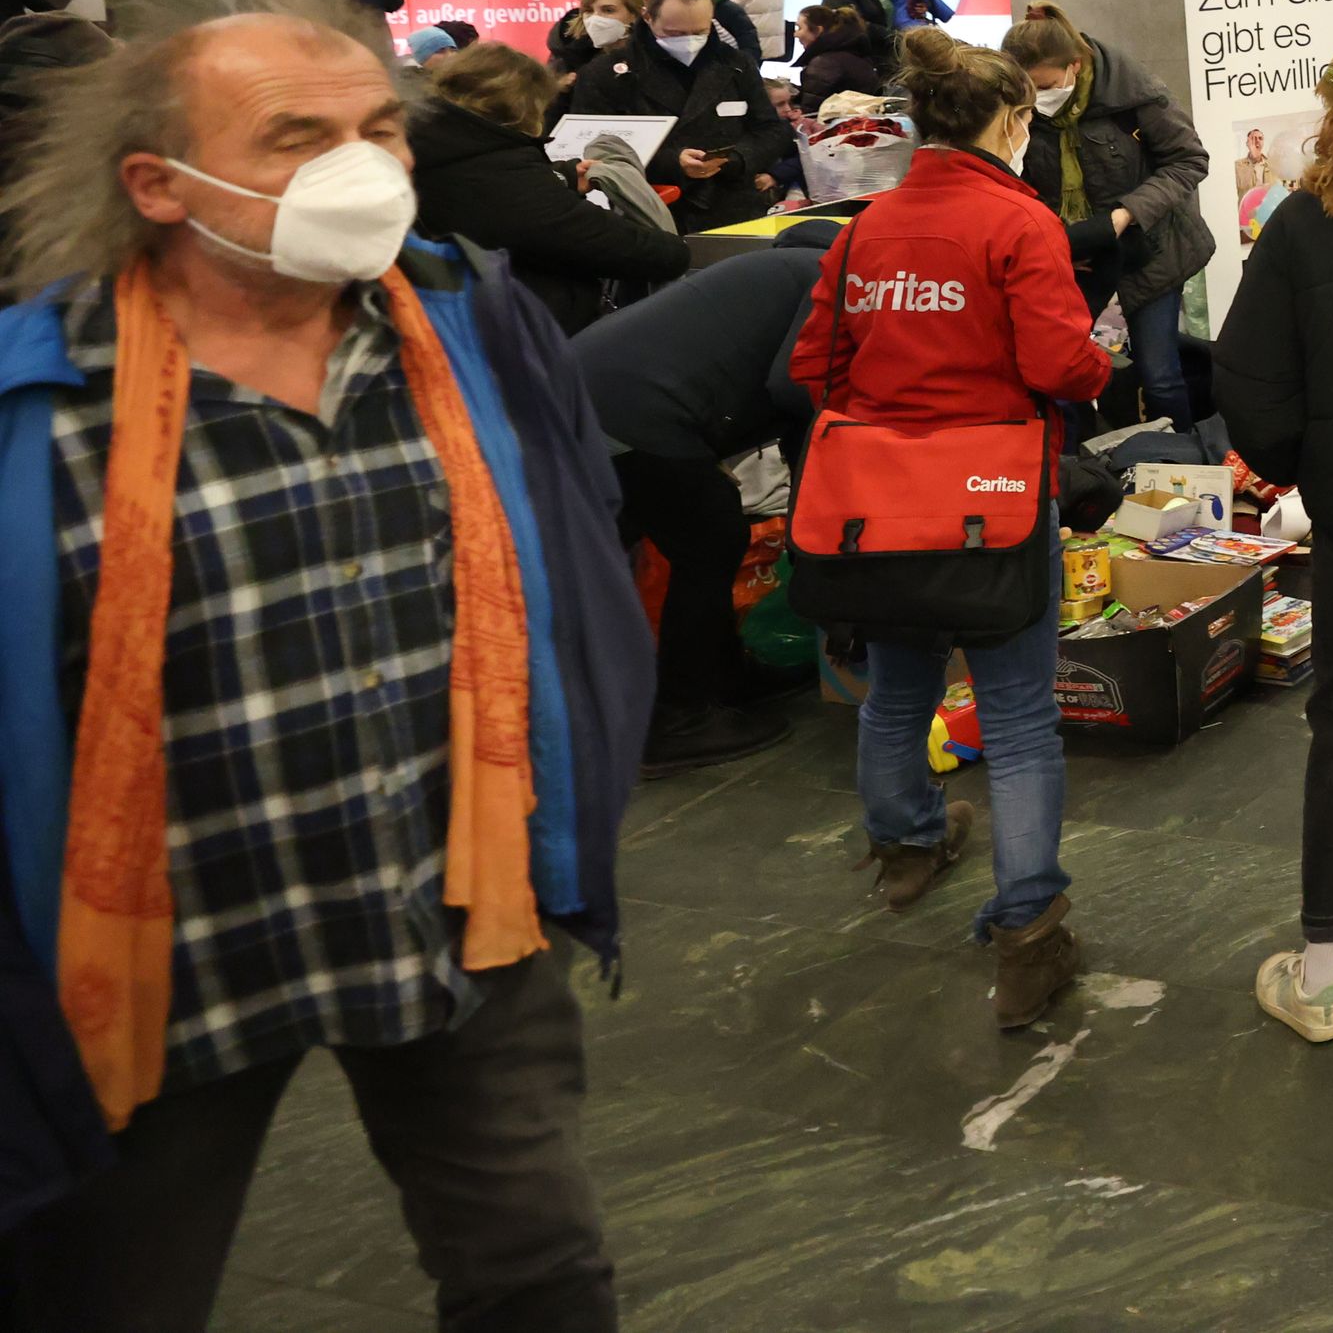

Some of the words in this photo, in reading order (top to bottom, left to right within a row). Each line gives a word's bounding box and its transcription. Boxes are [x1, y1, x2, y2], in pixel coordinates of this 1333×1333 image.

[384, 8, 409, 25] es
[416, 2, 477, 24] außer
[1201, 24, 1265, 65] gibt
[1274, 21, 1312, 49] es
[844, 271, 966, 314] Caritas
[966, 475, 1027, 493] Caritas
